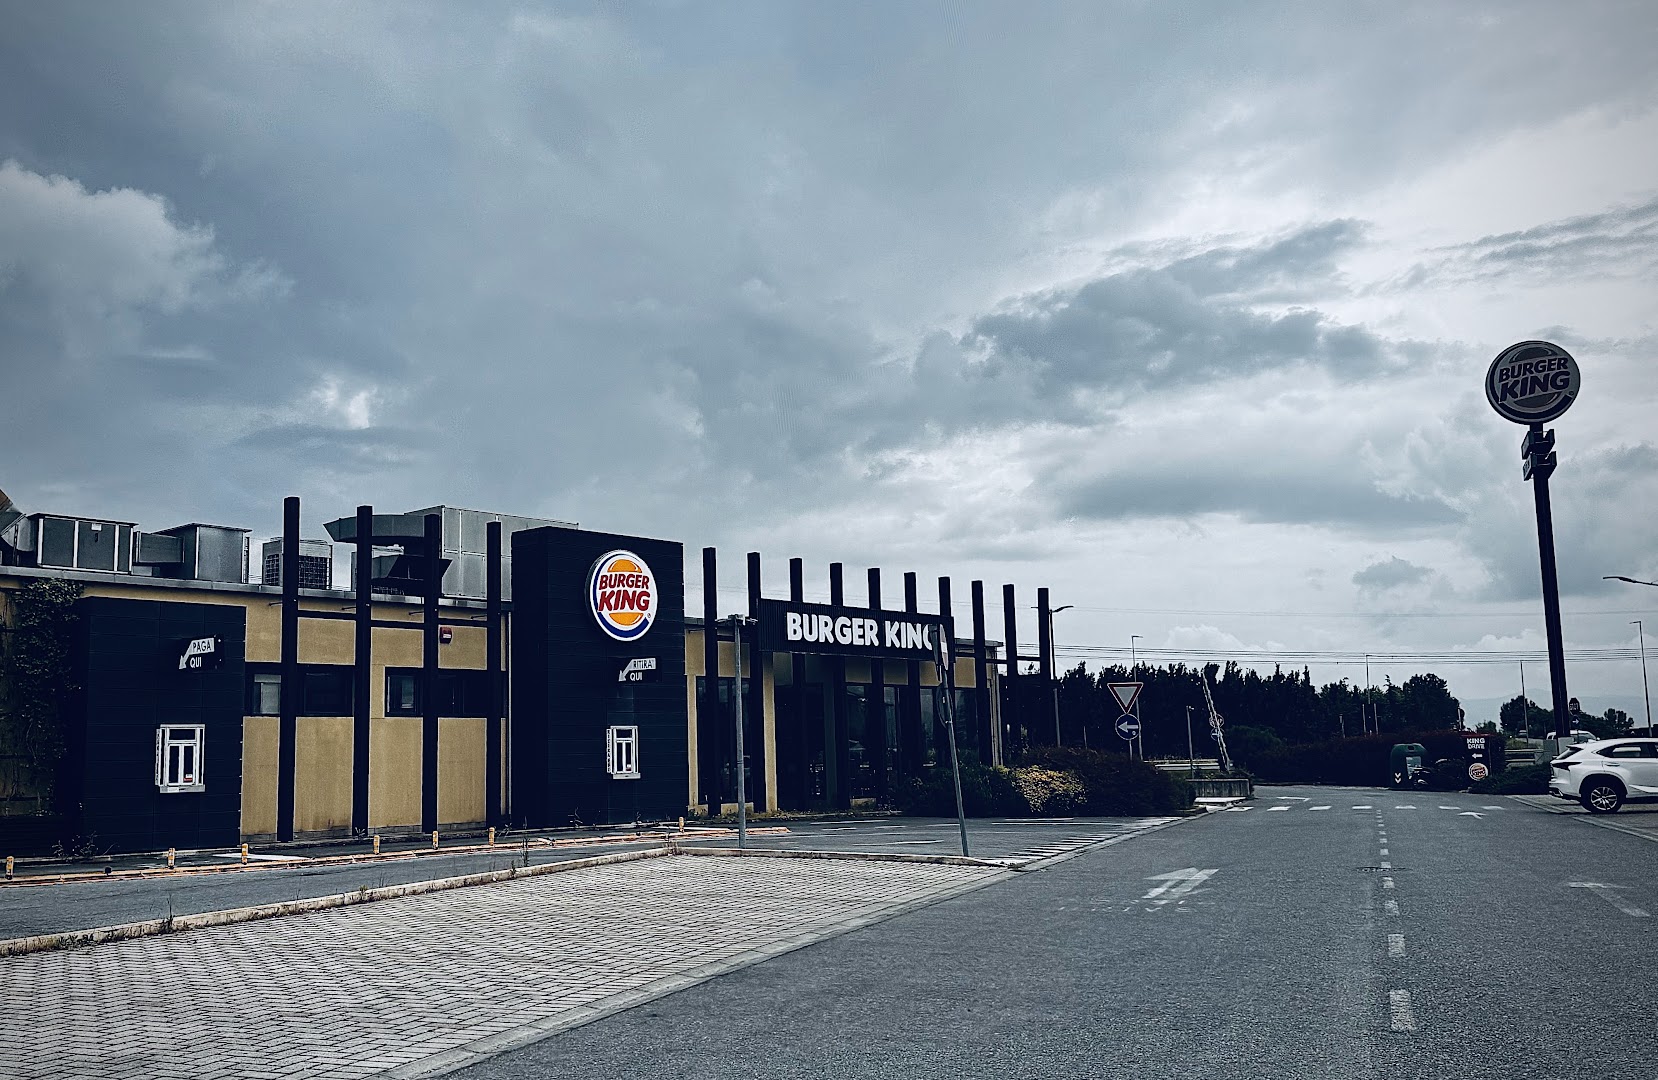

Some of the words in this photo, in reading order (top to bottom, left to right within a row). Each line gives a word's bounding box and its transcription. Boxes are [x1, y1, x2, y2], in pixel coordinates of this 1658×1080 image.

[1499, 358, 1568, 383] BURGER
[1500, 370, 1570, 401] KING
[598, 573, 650, 590] BURGER
[598, 589, 651, 612] KING
[786, 611, 879, 647] BURGER
[192, 640, 212, 652] PAGA
[190, 656, 202, 668] QUI
[629, 671, 643, 681] QUI
